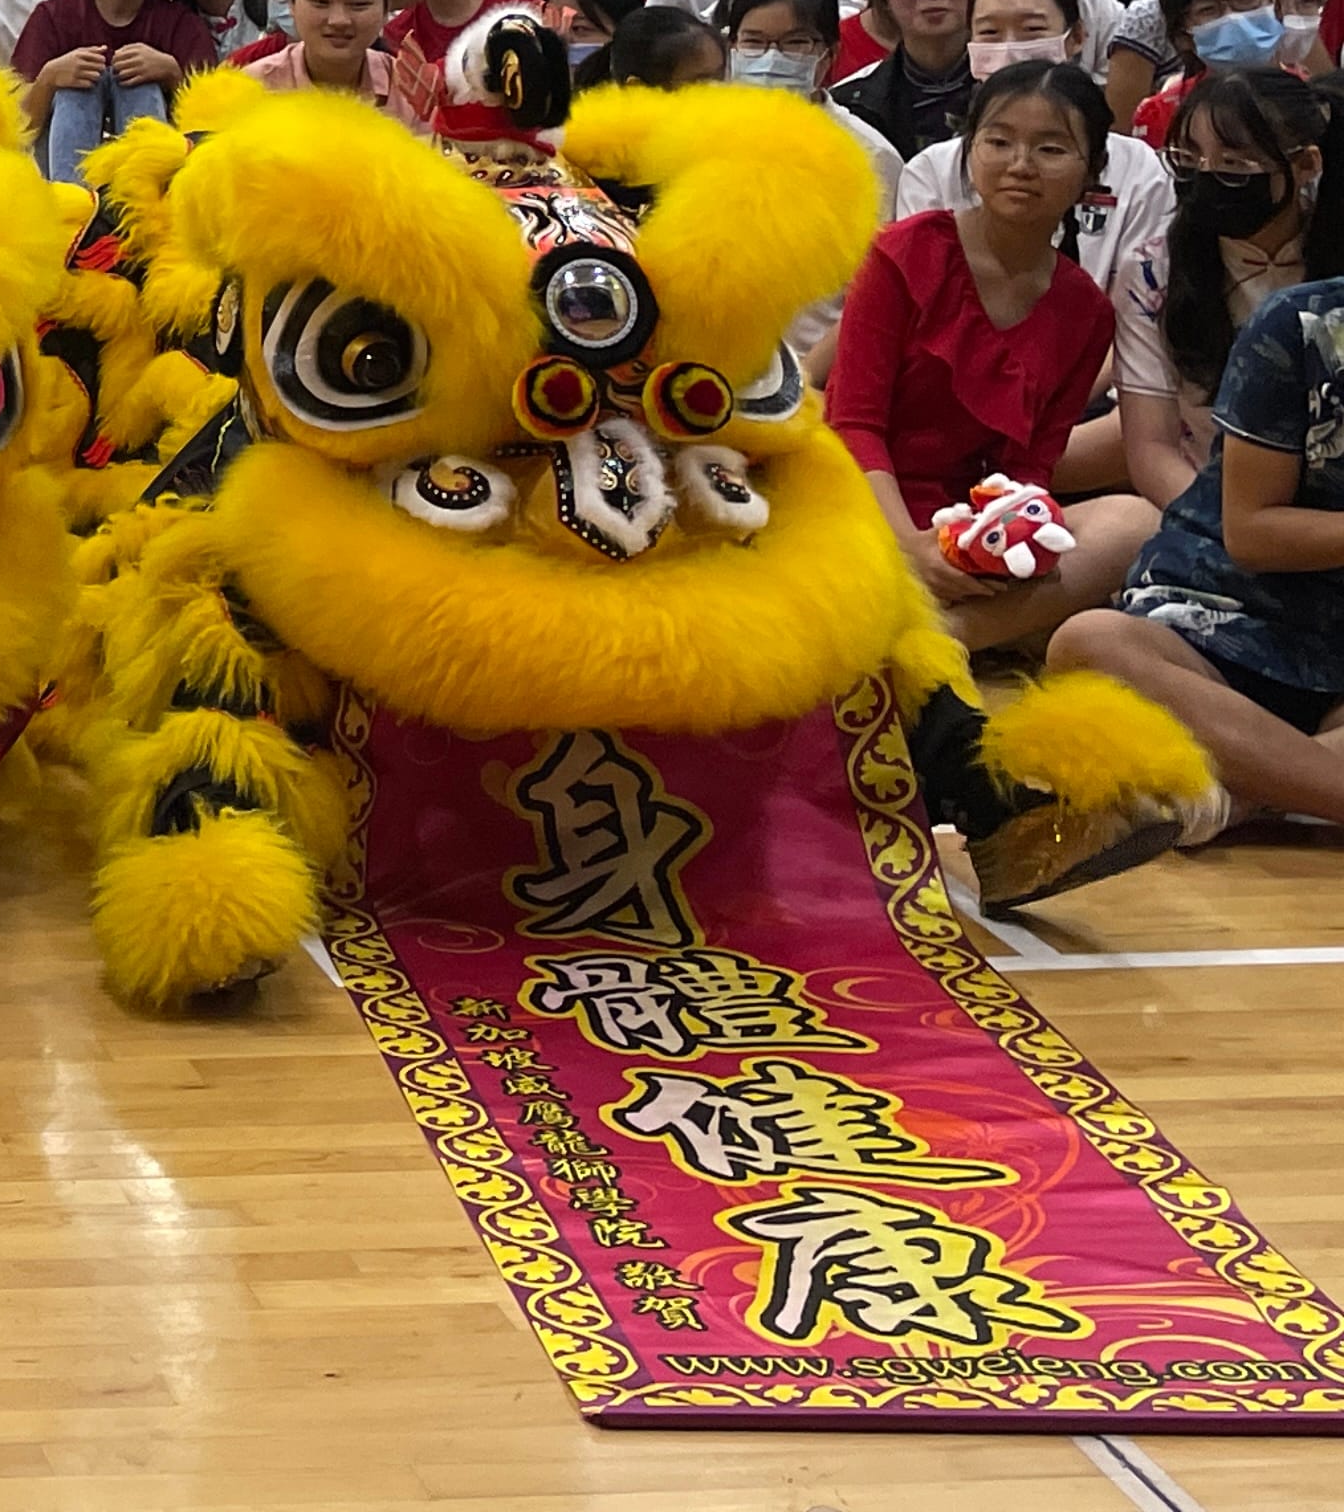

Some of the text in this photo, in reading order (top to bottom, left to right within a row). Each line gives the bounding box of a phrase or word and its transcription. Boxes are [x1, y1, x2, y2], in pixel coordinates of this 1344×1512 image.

[510, 729, 1084, 1343] 身體健康
[663, 1349, 1316, 1386] www.sgweieng.com
